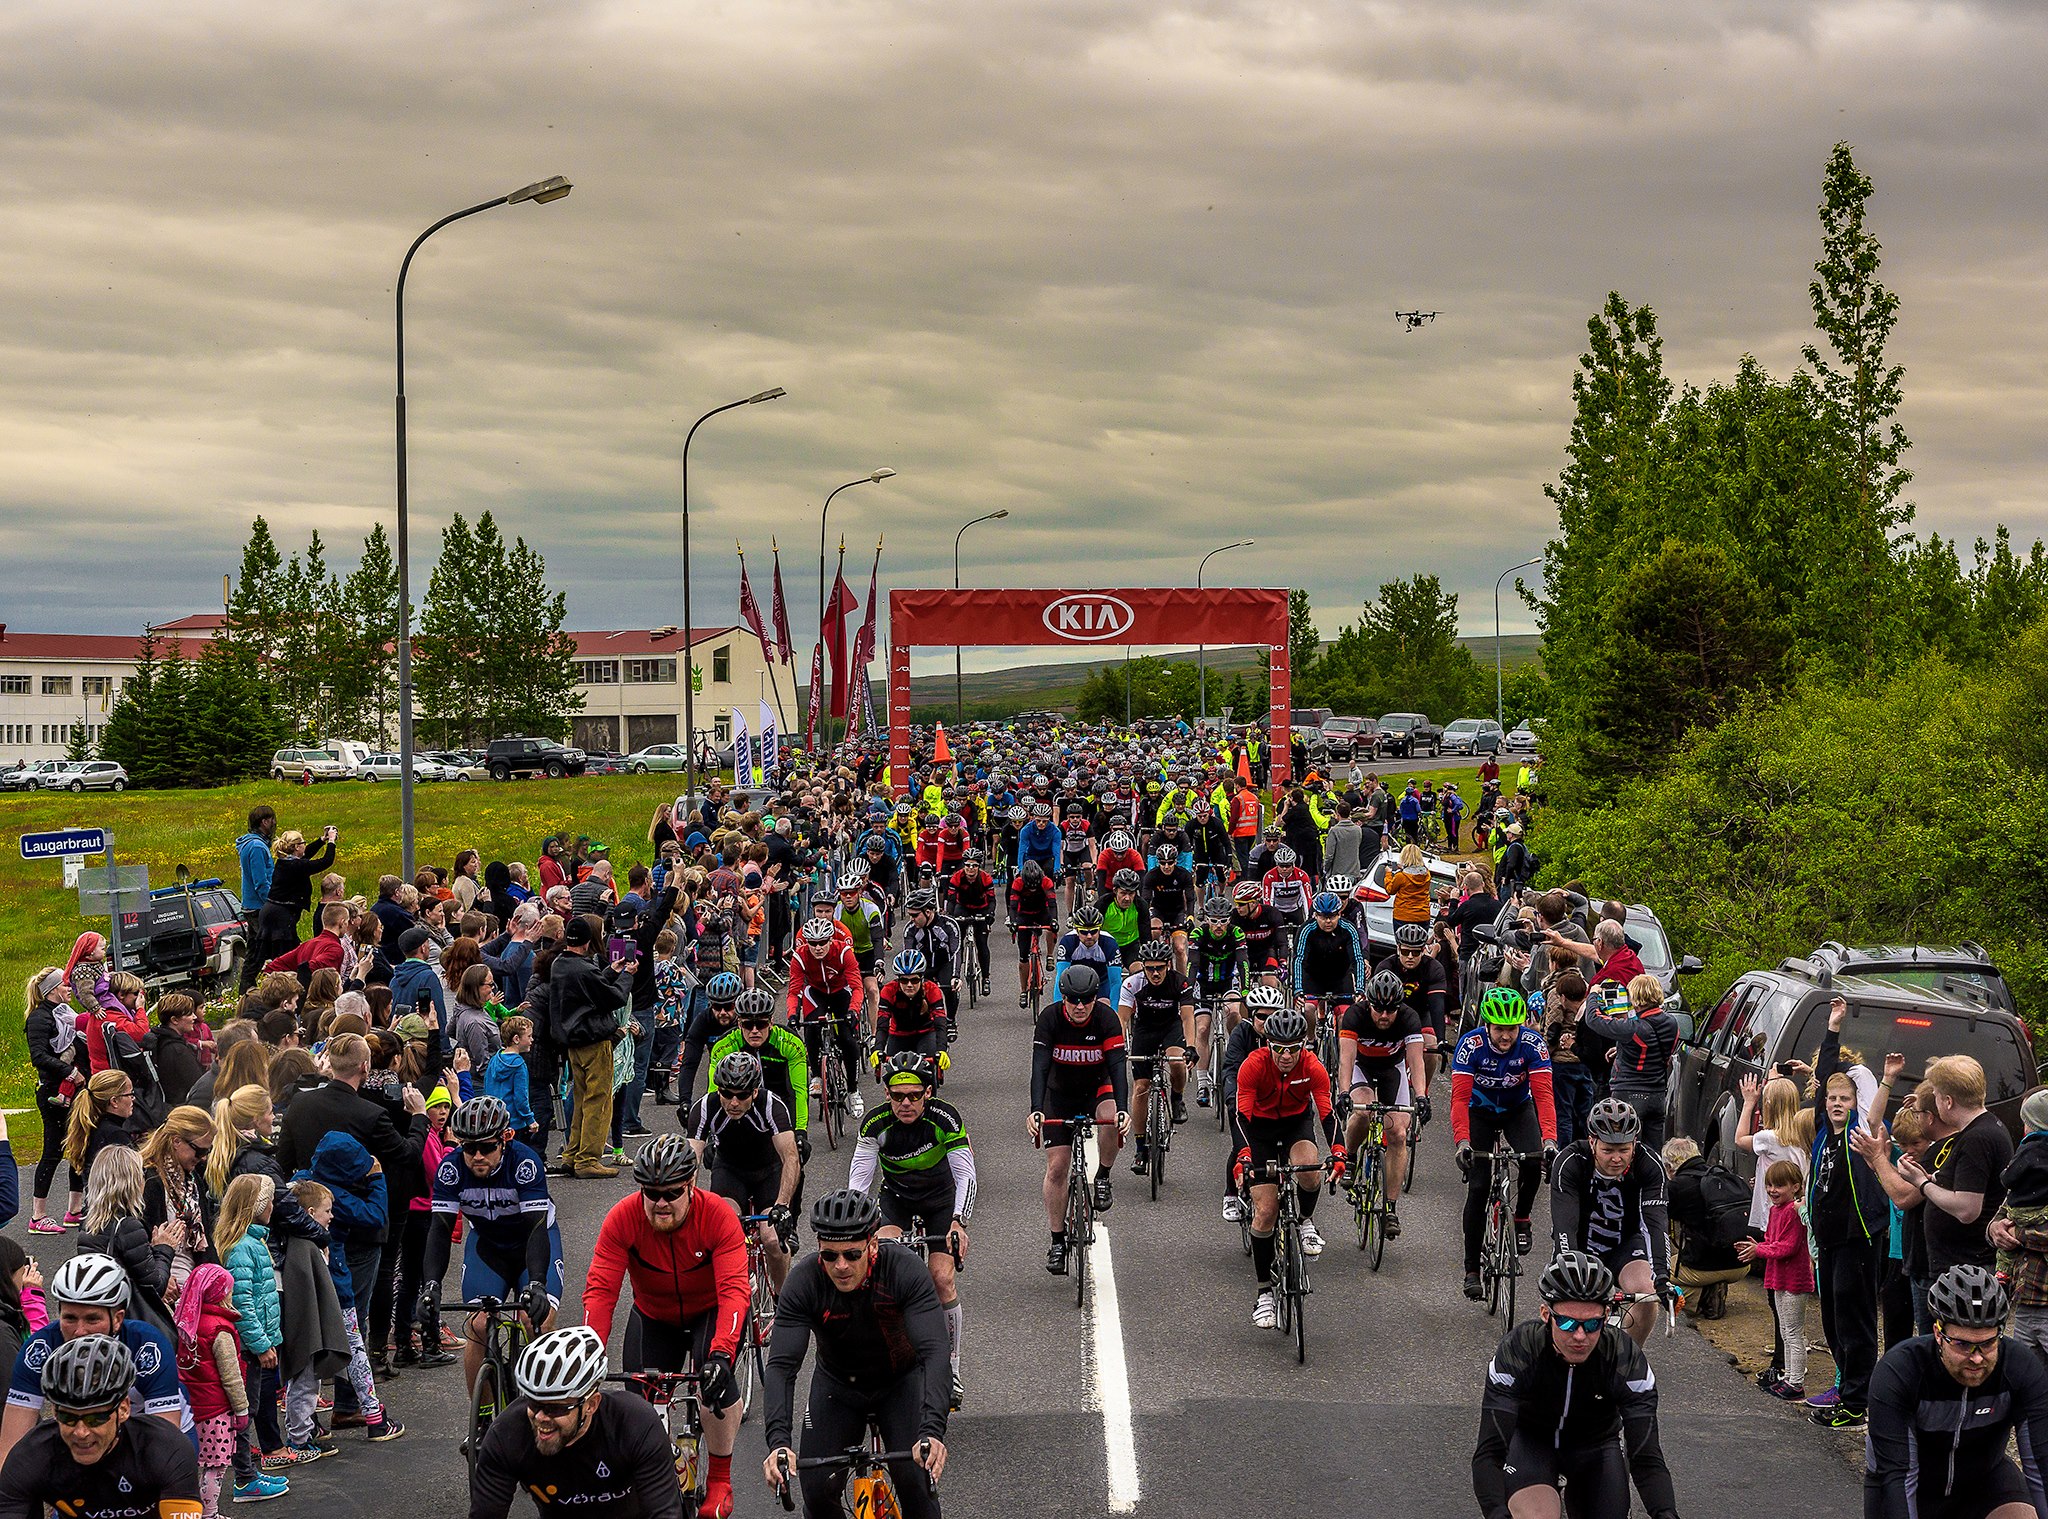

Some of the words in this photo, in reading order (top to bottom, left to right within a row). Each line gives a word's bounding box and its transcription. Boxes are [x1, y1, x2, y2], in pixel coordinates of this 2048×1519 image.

[1058, 604, 1119, 630] KIA
[24, 836, 102, 854] Laugarbraut
[123, 911, 139, 924] 112
[1052, 1048, 1103, 1062] BJARTUR
